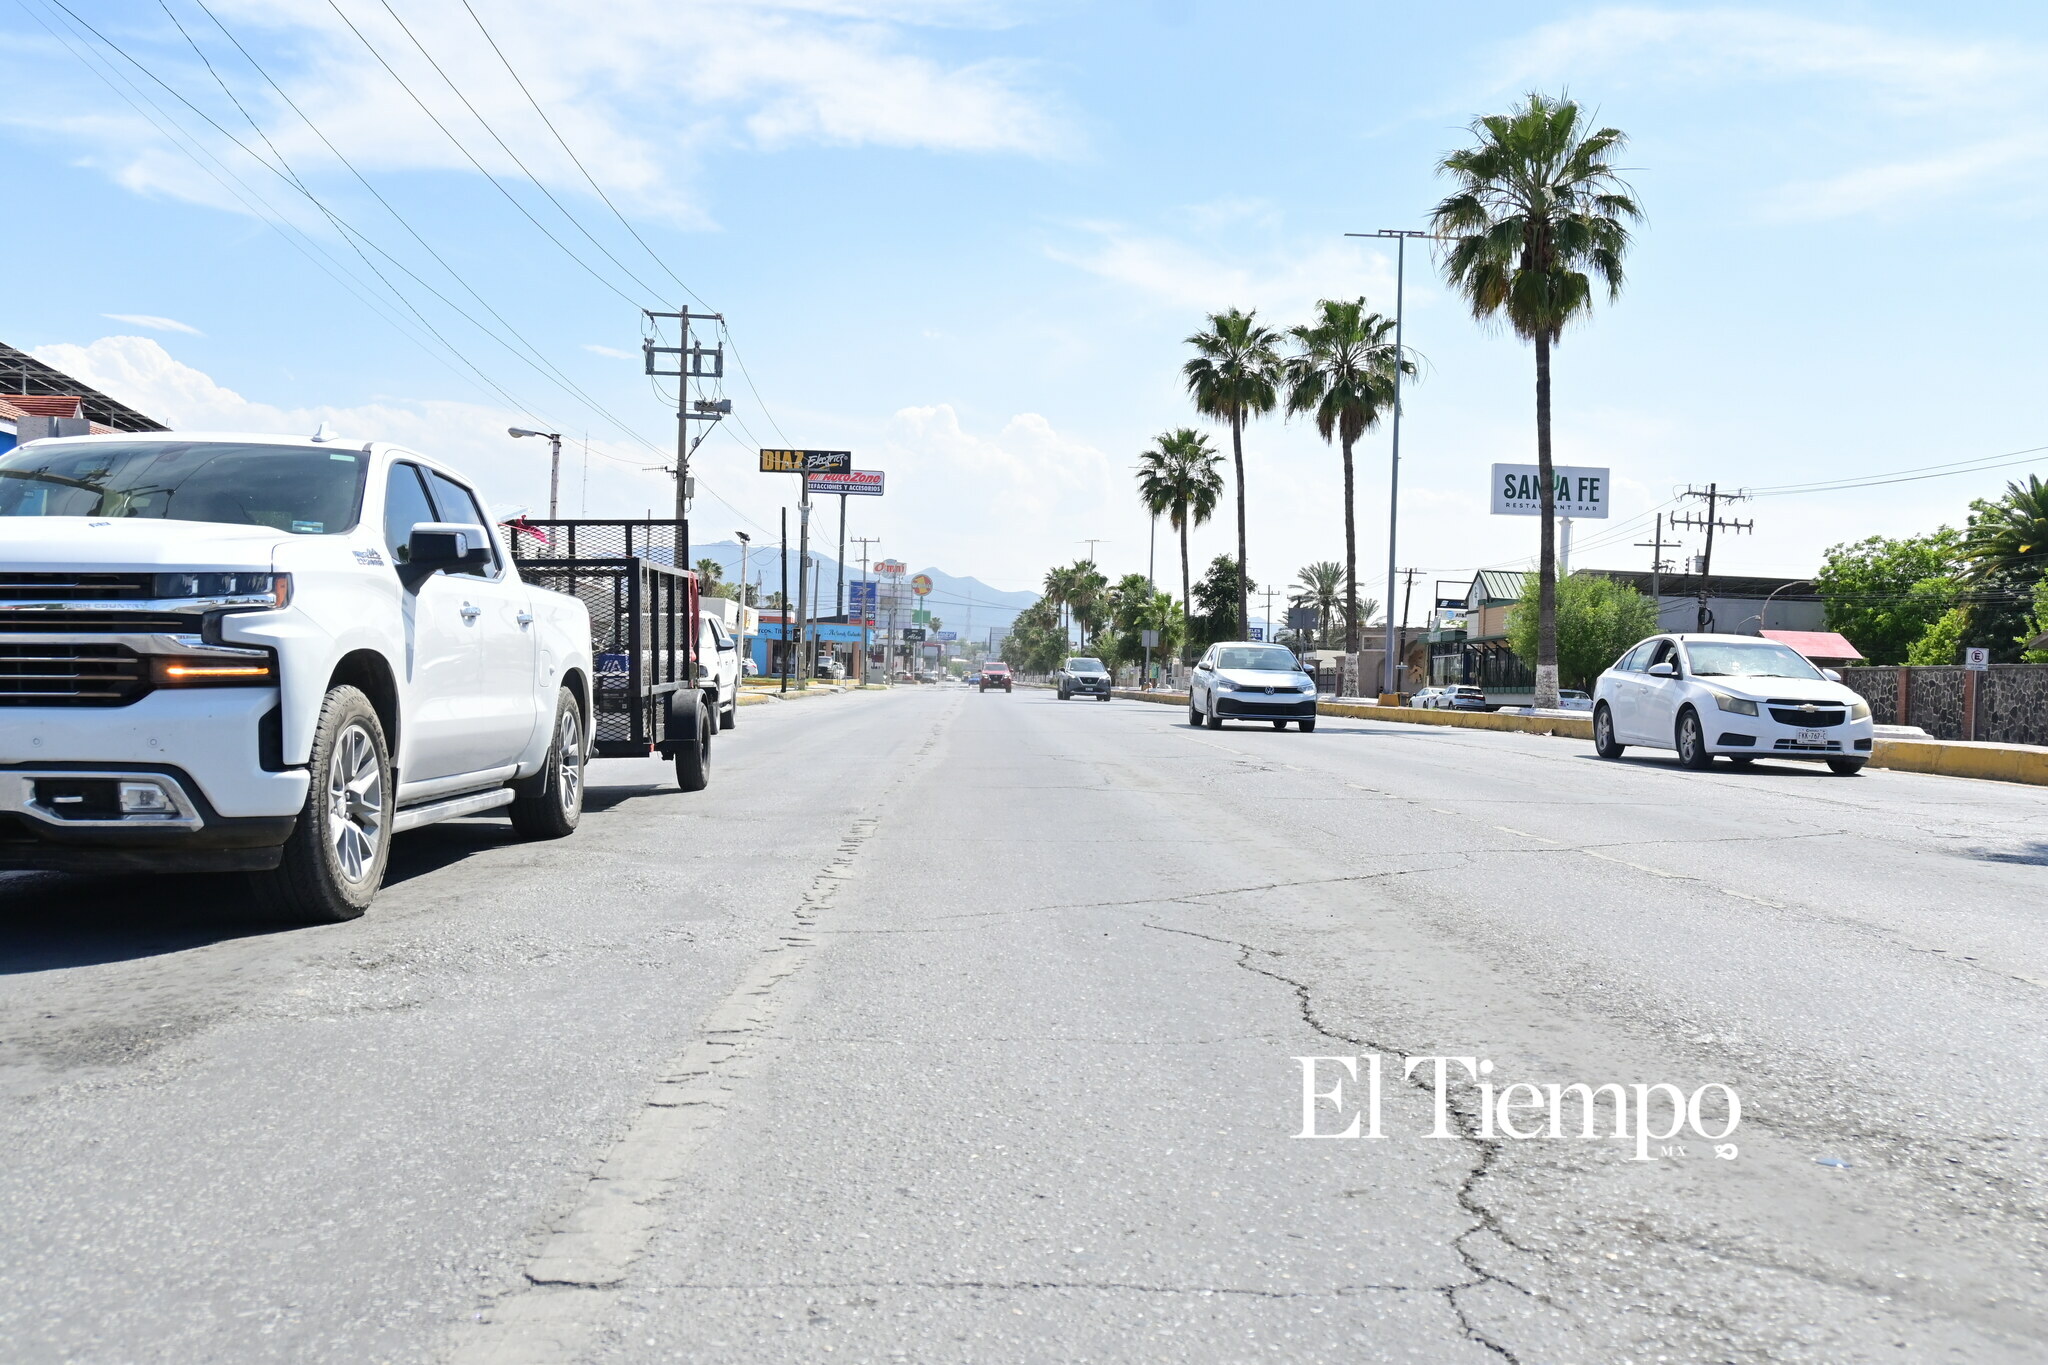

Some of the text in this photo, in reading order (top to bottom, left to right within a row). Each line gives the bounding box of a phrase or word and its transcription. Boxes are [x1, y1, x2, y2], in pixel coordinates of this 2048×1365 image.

[762, 450, 804, 470] DIAZ
[823, 472, 881, 483] AutoZone
[849, 484, 881, 492] ACCESORIOS
[1578, 477, 1600, 502] FE
[1505, 502, 1571, 510] RESTAUANT
